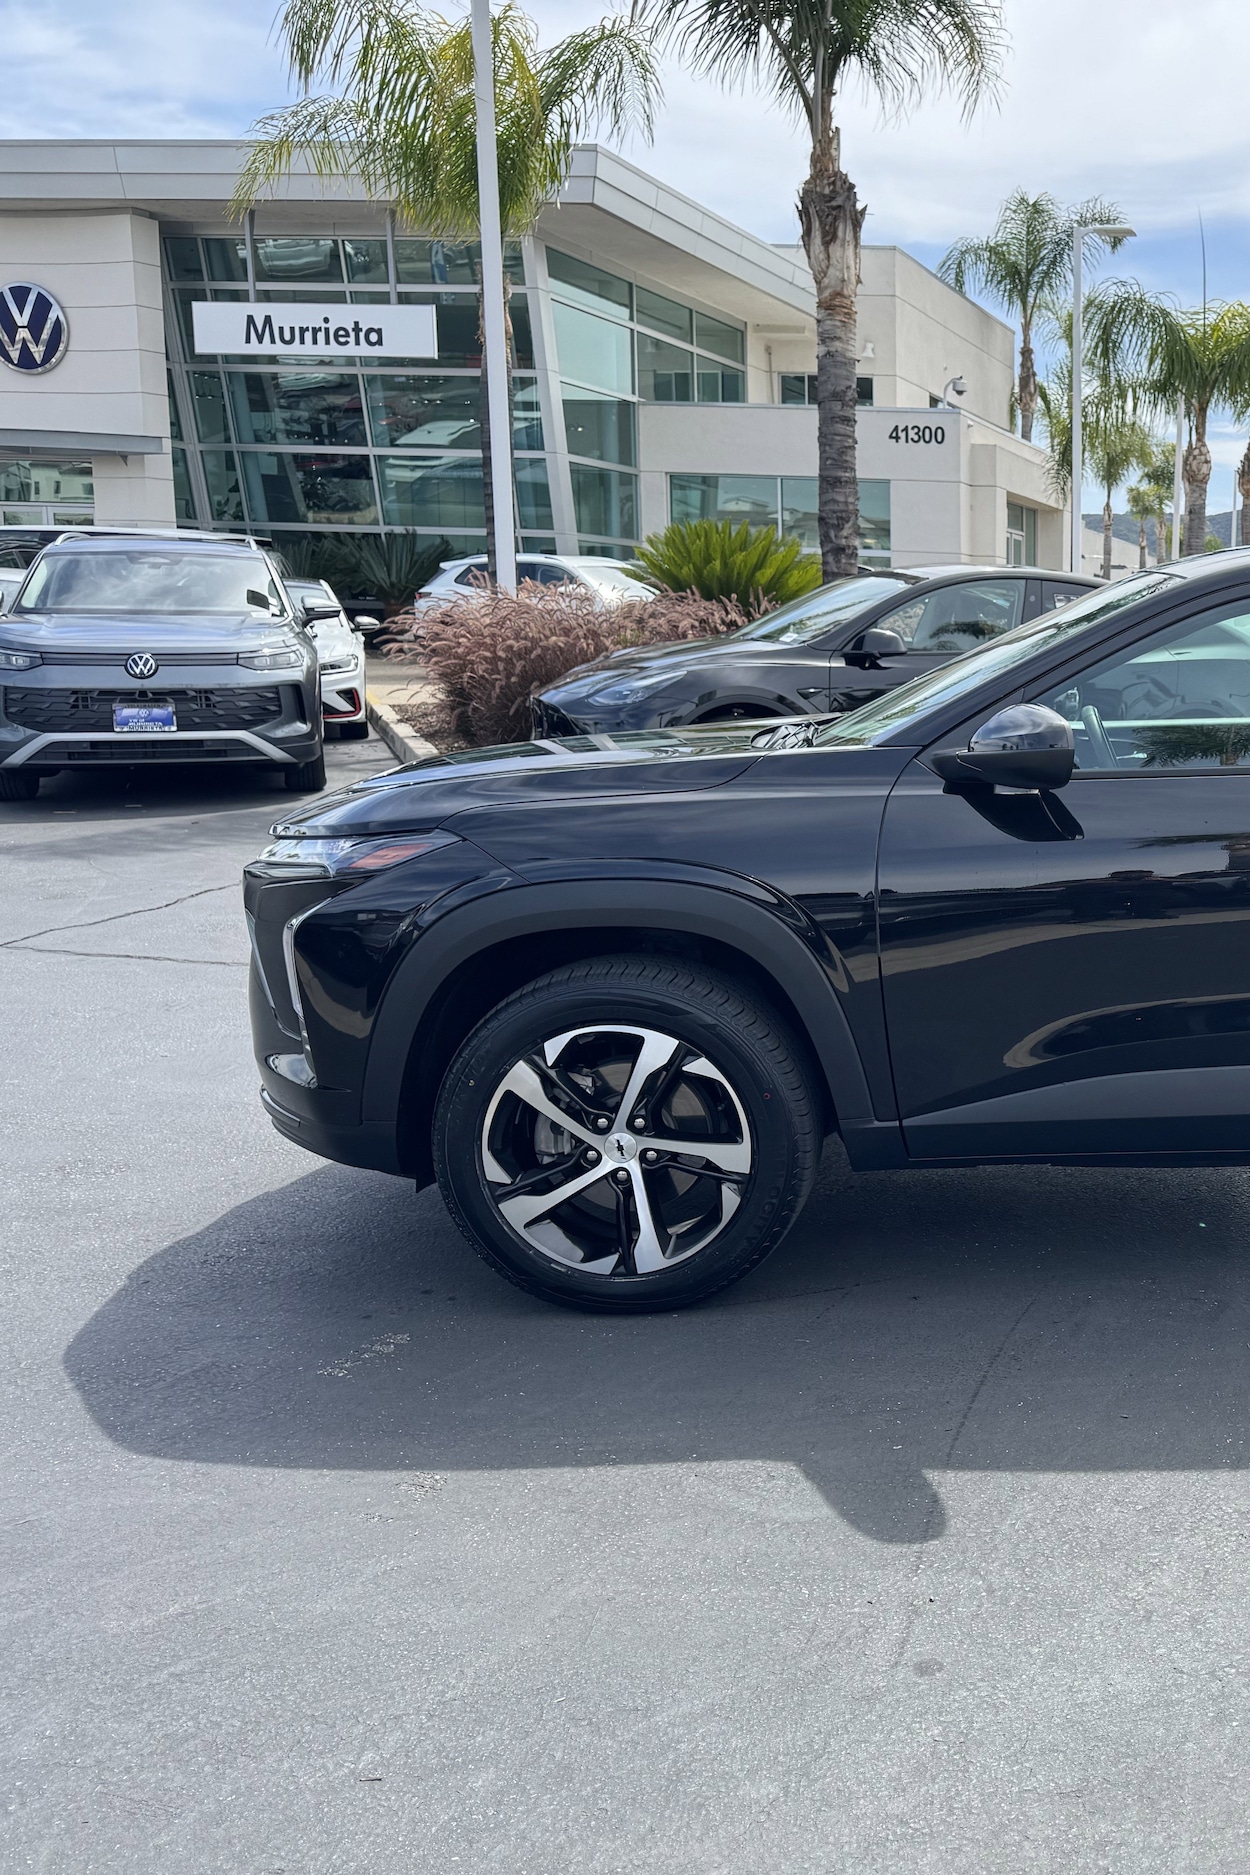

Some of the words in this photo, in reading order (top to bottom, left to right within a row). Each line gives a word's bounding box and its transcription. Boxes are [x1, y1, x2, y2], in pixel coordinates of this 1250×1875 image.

[0, 285, 60, 364] VW
[245, 315, 384, 347] Murrieta
[889, 425, 945, 444] 41300
[127, 653, 156, 676] VW
